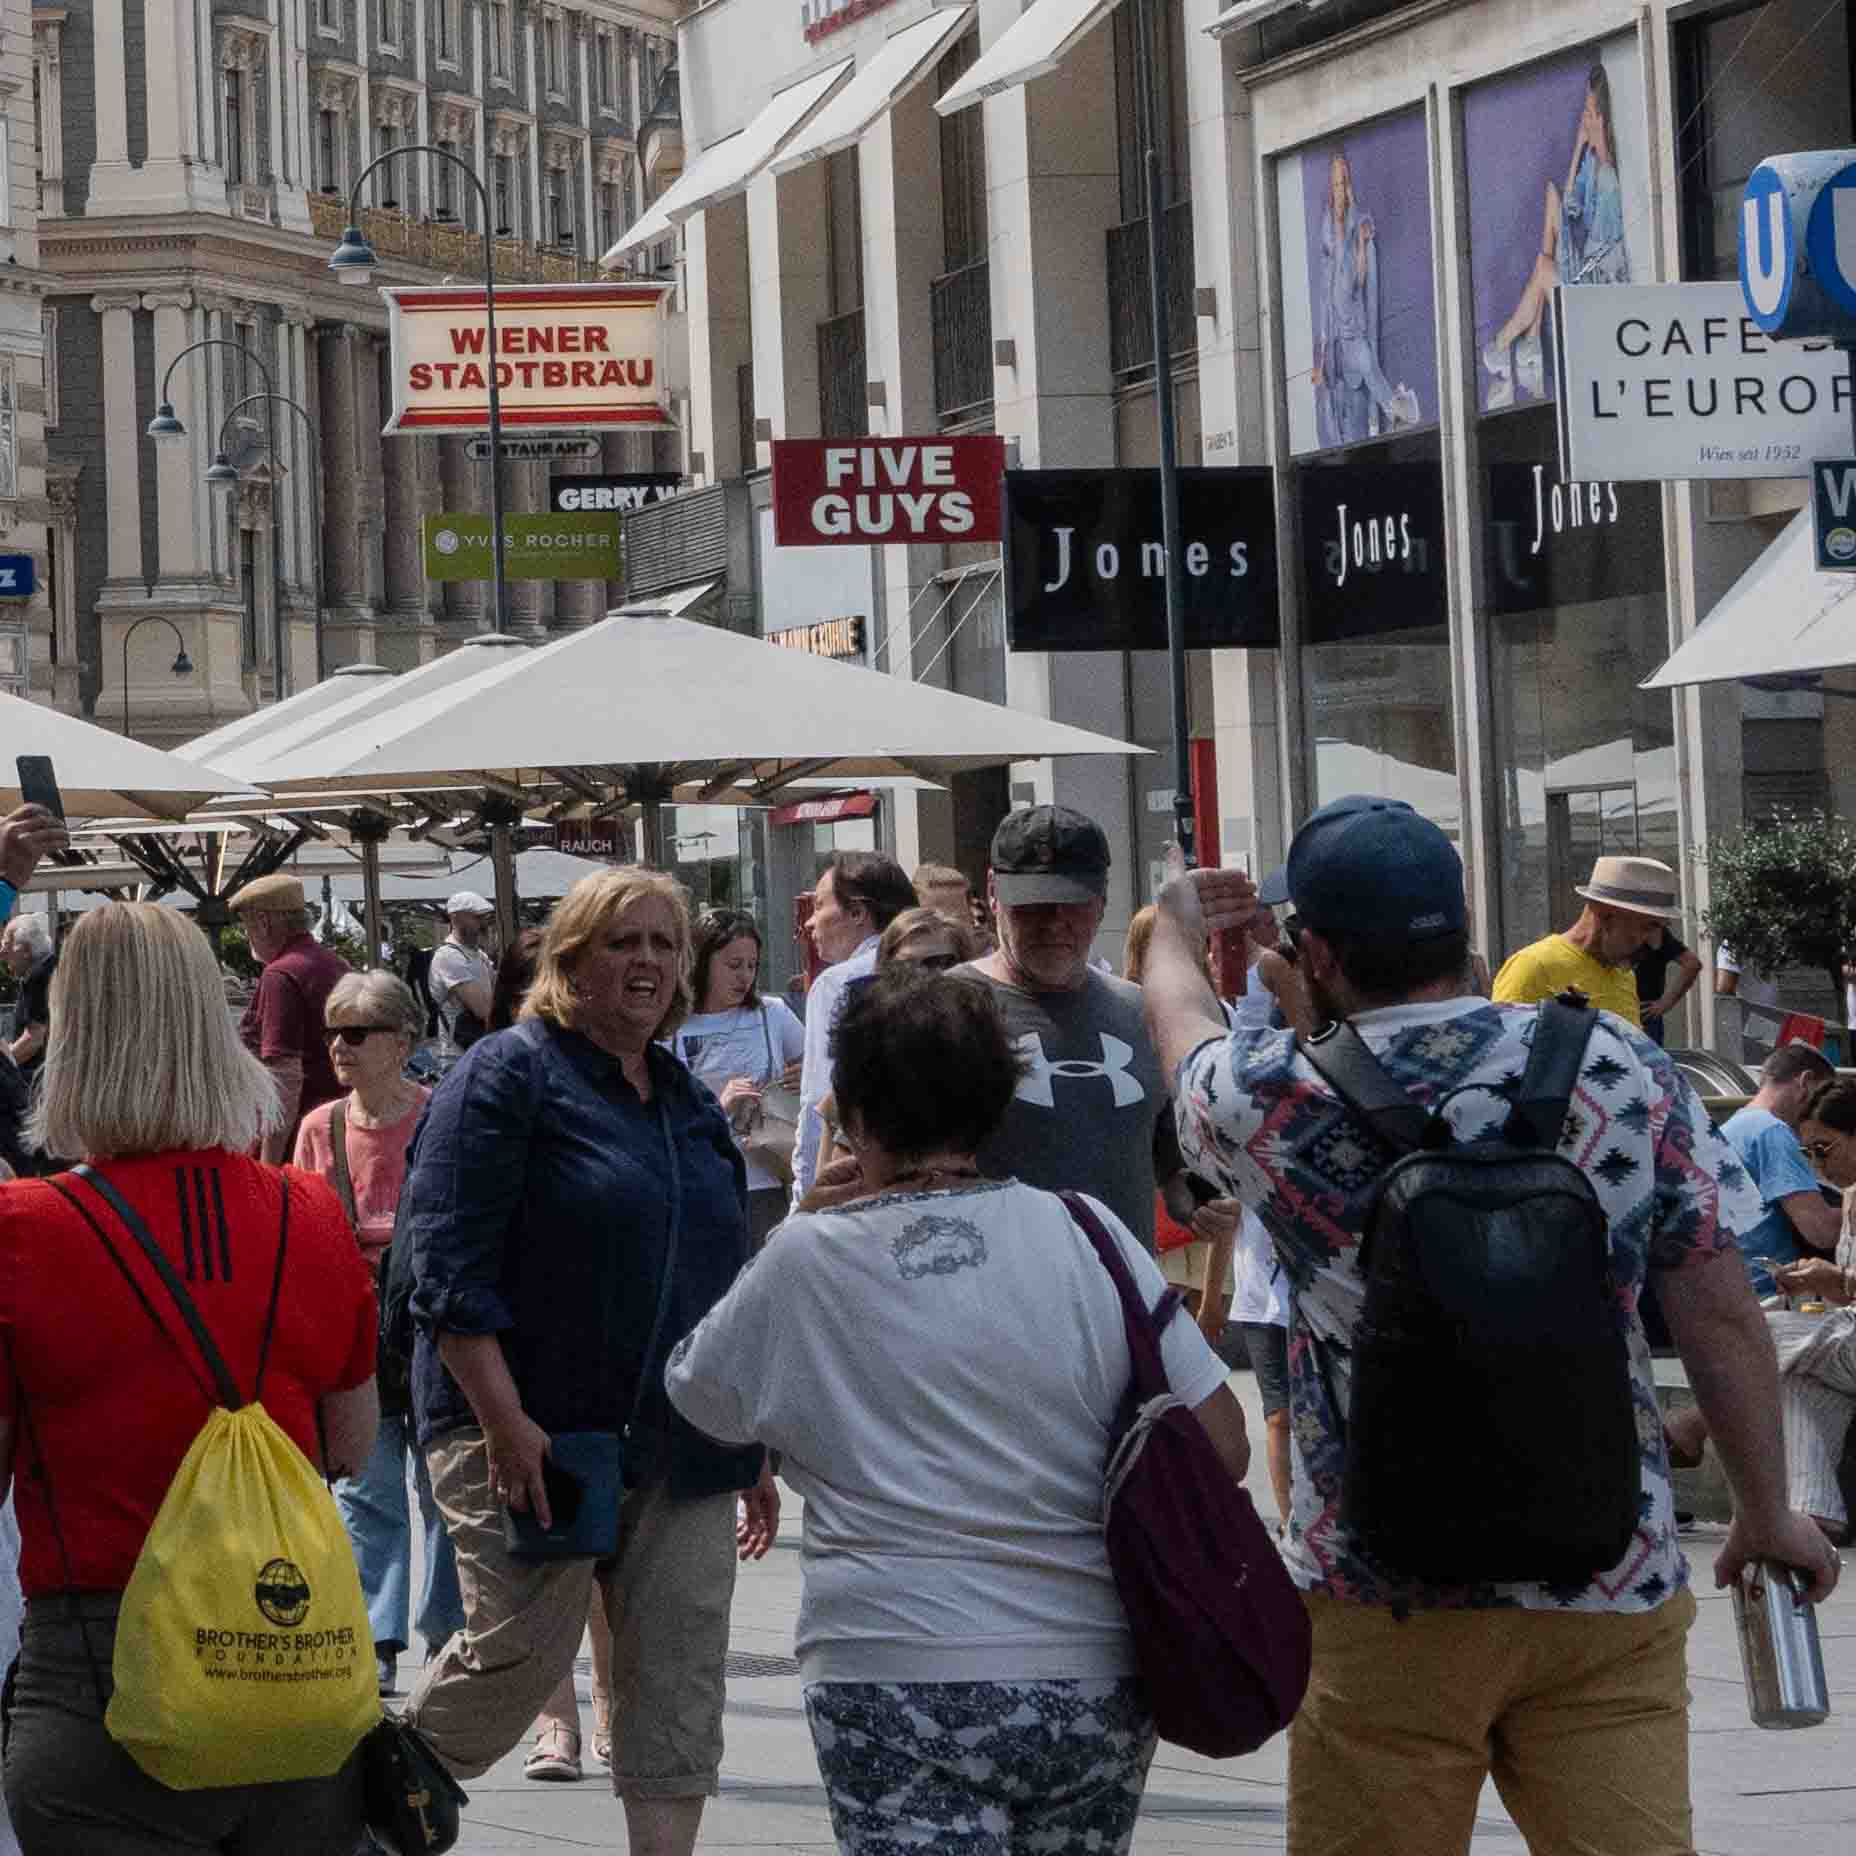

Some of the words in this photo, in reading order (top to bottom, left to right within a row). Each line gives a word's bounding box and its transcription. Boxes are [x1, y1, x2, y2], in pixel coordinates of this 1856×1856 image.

[1744, 190, 1787, 316] U
[450, 325, 609, 355] WENER
[409, 359, 654, 391] STADTBRÄU
[825, 445, 957, 488] FIVE
[558, 487, 650, 512] GERRY
[811, 490, 977, 536] GUYS
[1530, 463, 1619, 557] Jones
[465, 535, 513, 546] YVS
[527, 534, 611, 546] ROCHER
[1336, 504, 1413, 587] Jones
[1043, 526, 1251, 594] Jones
[561, 838, 613, 855] RAUCH
[196, 1628, 292, 1651] BROTHER'S
[295, 1626, 355, 1650] BROTHER
[195, 1646, 358, 1666] FOUNDATION
